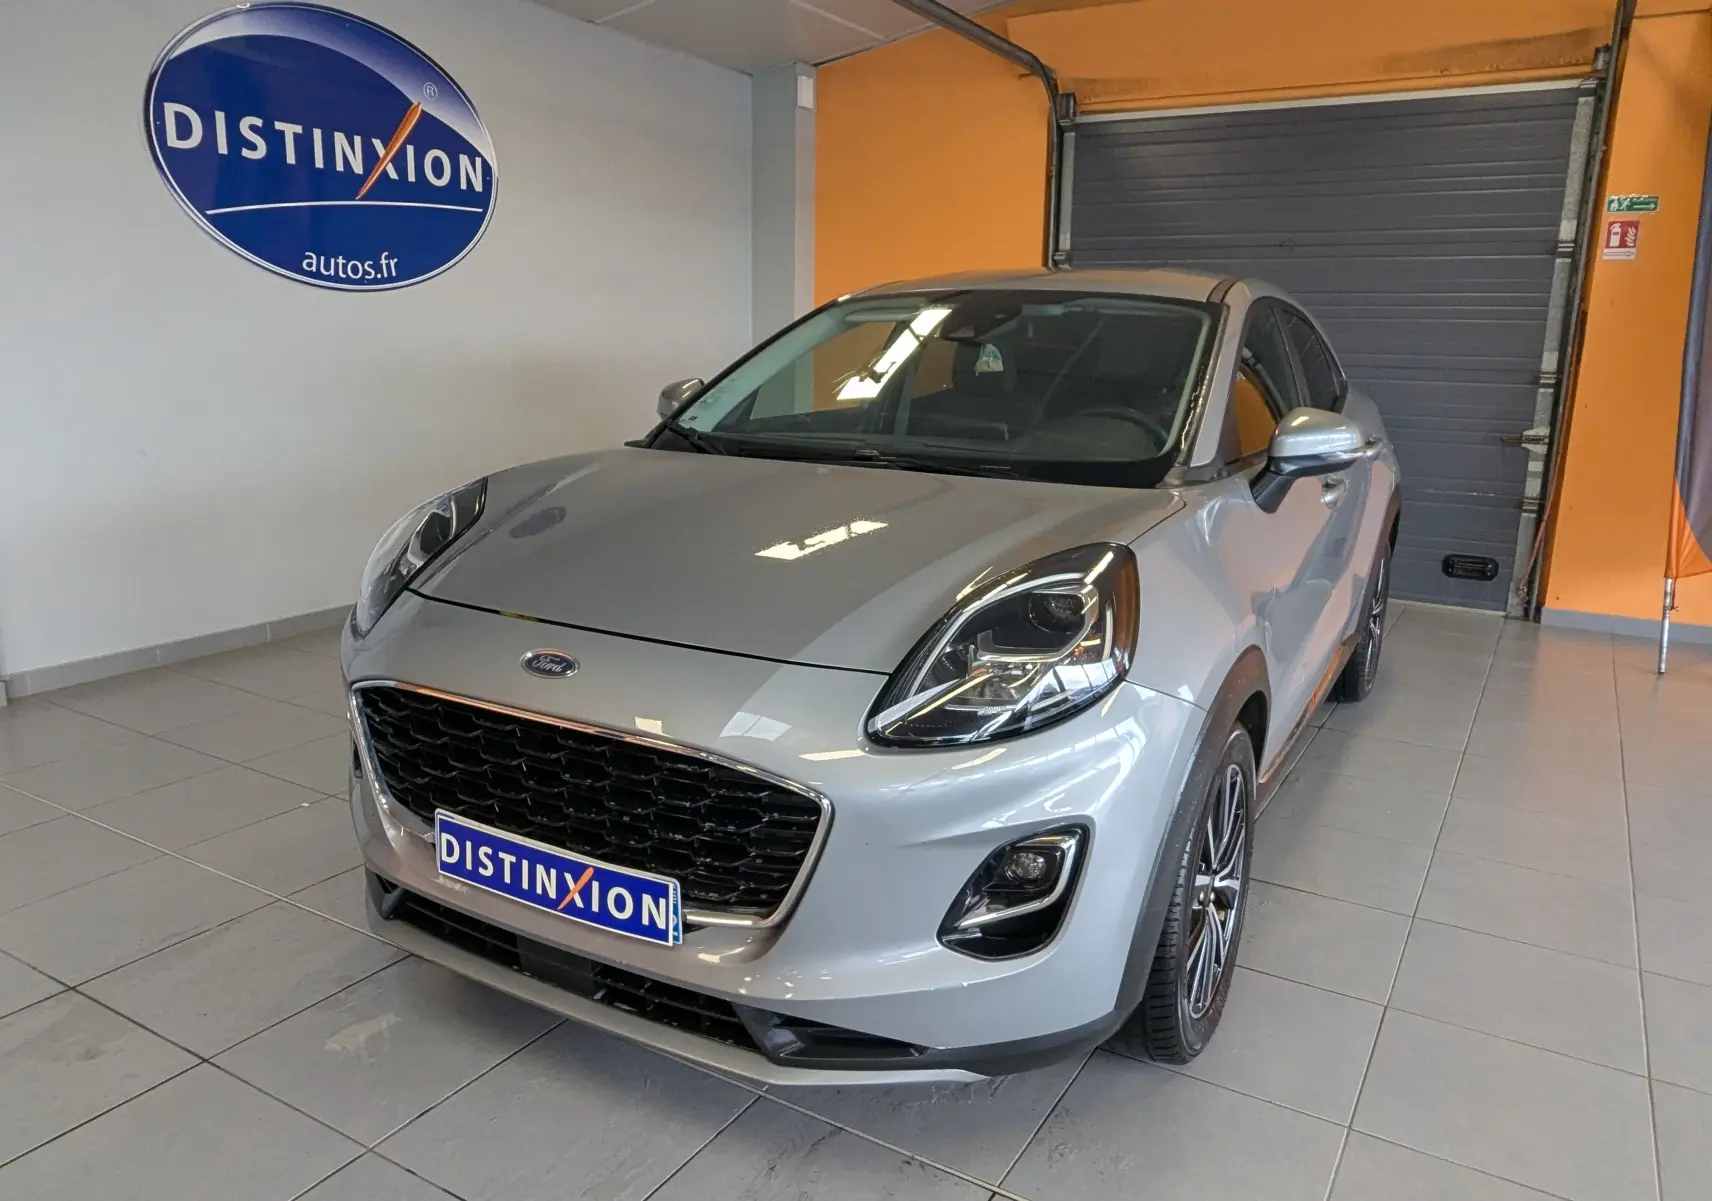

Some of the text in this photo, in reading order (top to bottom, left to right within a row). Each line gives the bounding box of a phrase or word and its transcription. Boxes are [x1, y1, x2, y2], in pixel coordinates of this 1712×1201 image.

[163, 101, 484, 199] DISTINXION
[302, 251, 399, 279] autos.fr
[532, 655, 567, 672] Ford
[440, 832, 667, 930] DISTINXION
